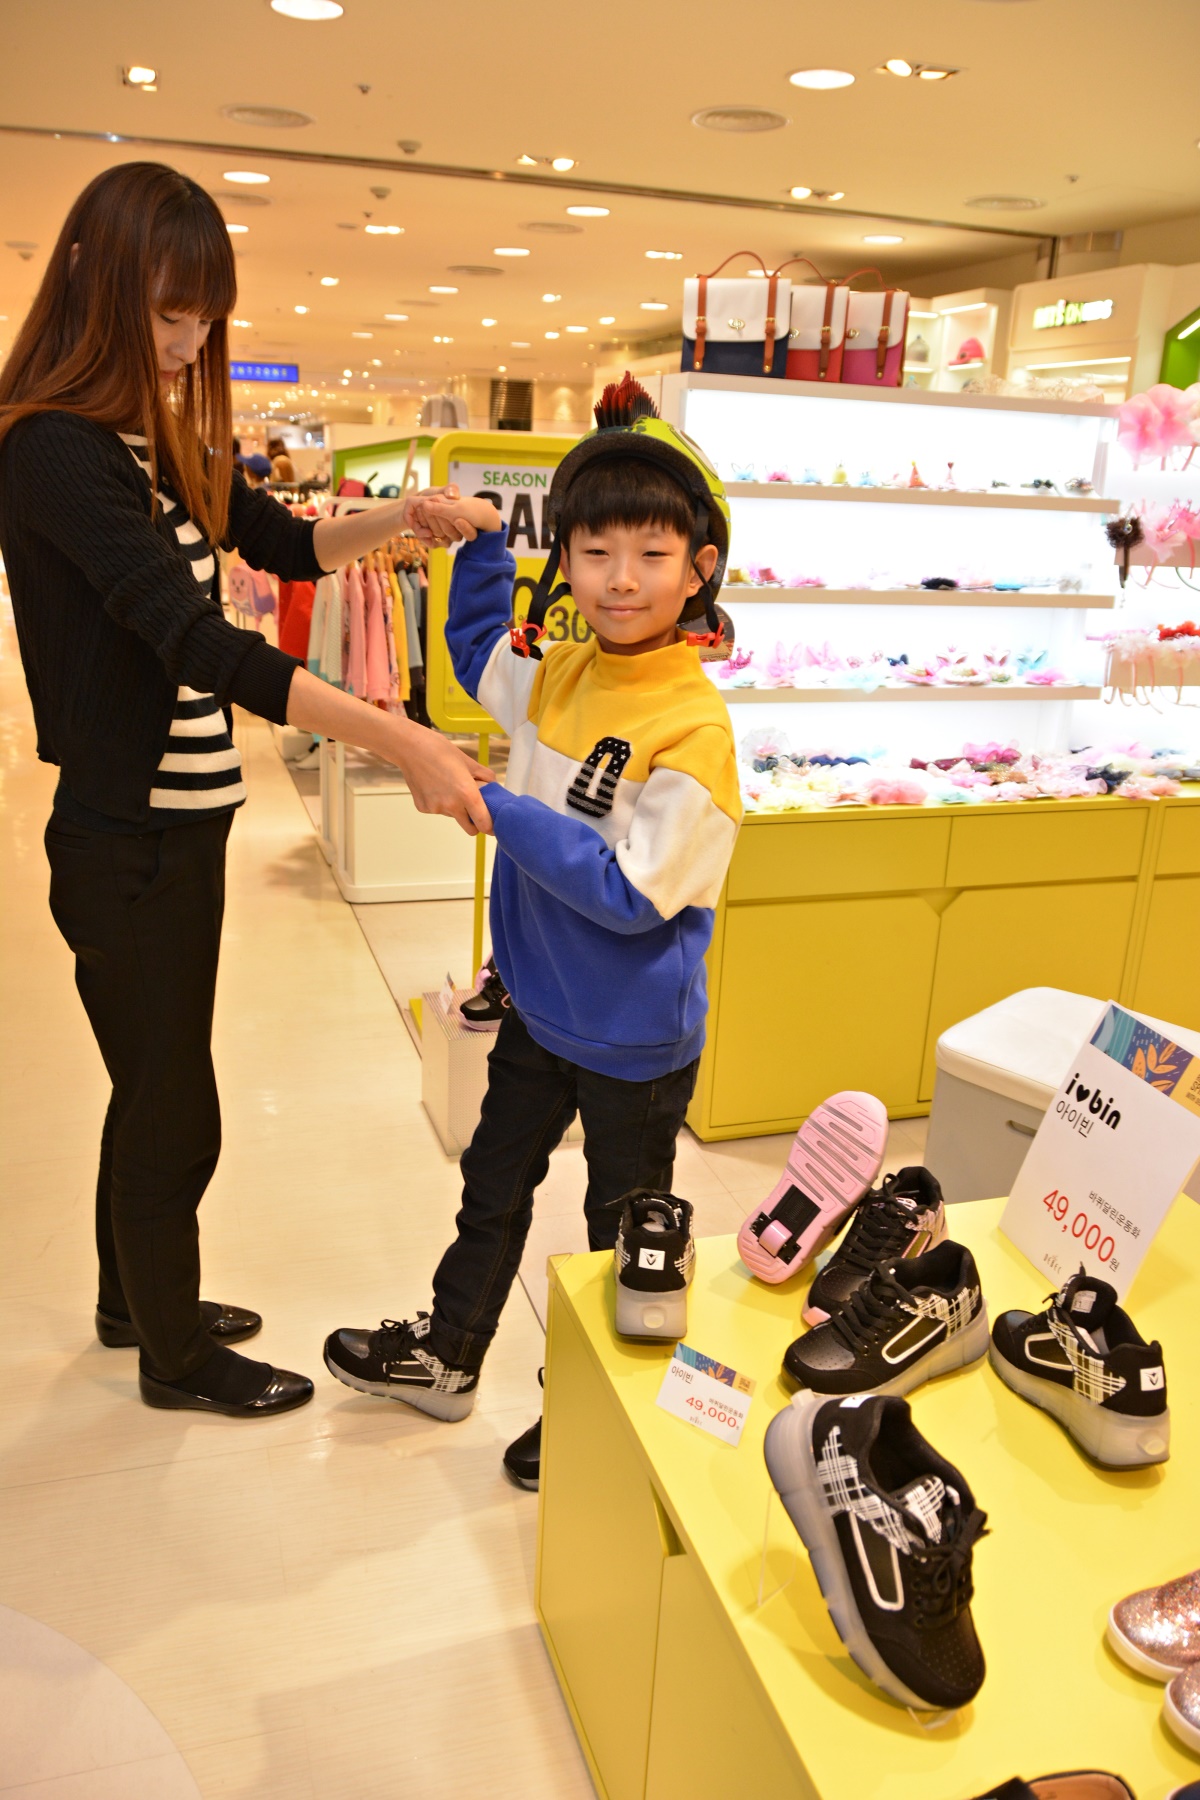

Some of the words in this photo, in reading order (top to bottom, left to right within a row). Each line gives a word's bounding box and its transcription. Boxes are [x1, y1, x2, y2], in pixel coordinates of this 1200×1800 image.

[483, 471, 547, 488] SEASON
[1056, 1100, 1094, 1138] 아이빈
[1088, 1190, 1141, 1239] 바퀴달린운동화
[671, 1365, 694, 1384] 아이빈
